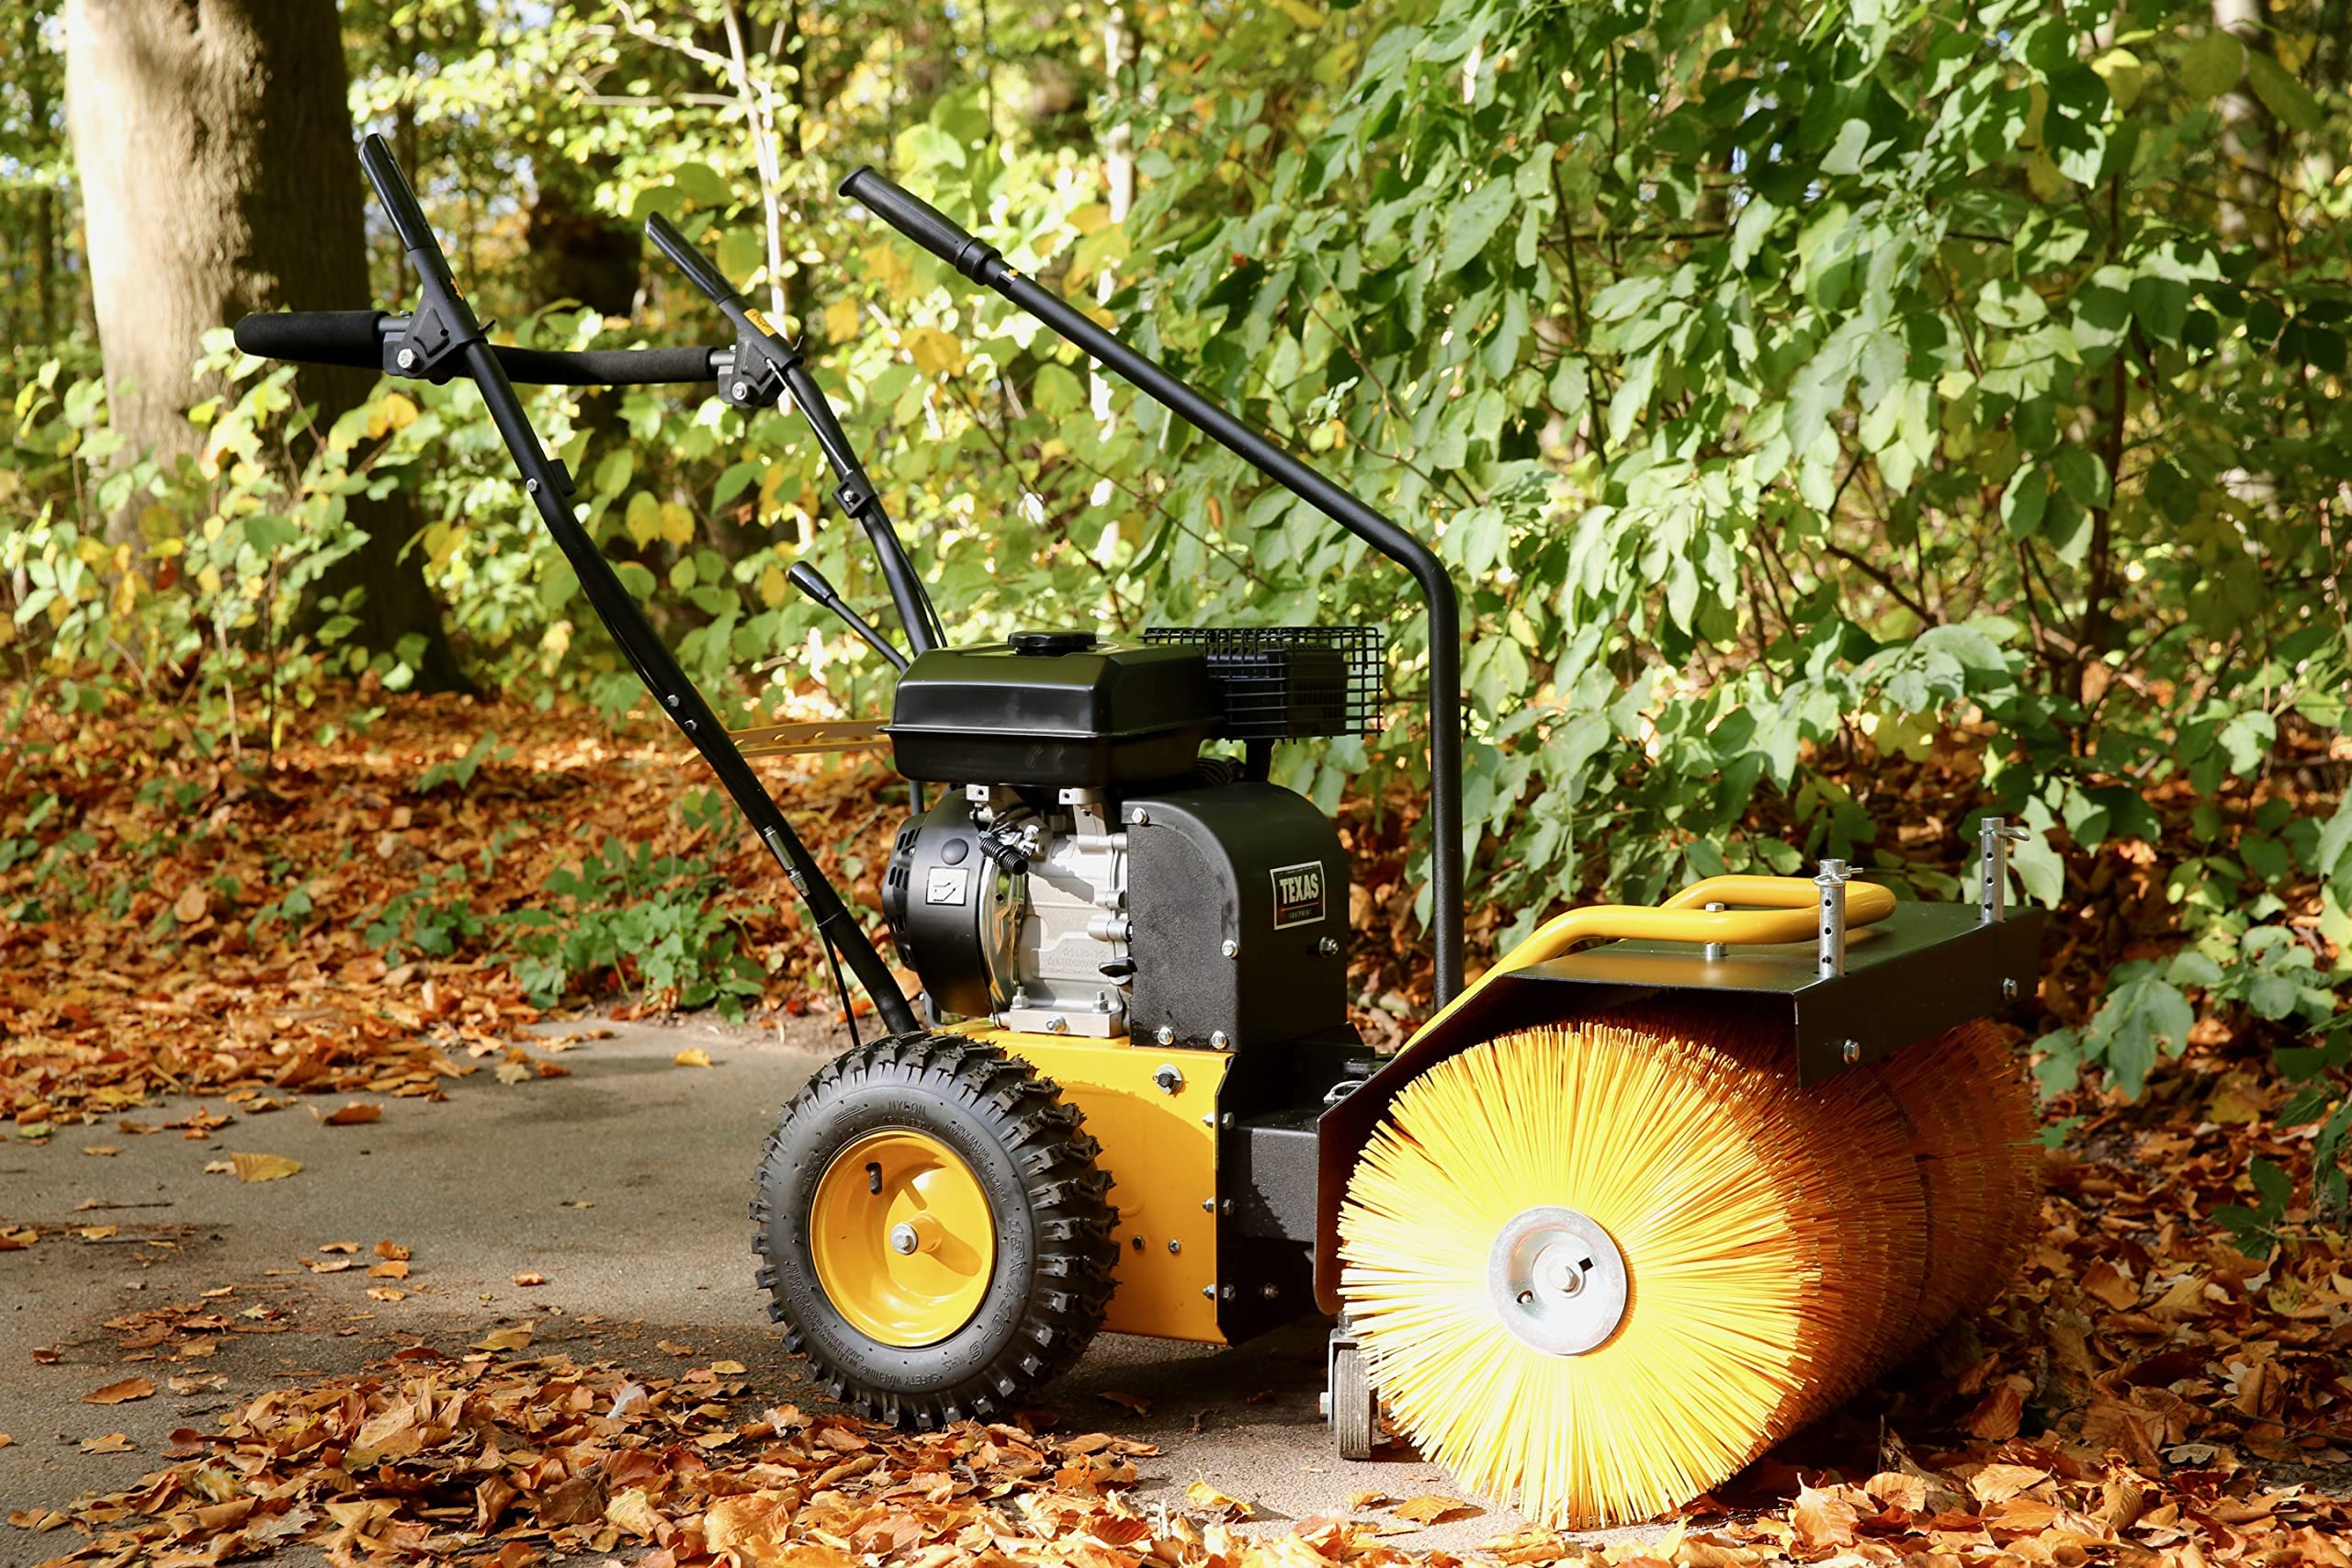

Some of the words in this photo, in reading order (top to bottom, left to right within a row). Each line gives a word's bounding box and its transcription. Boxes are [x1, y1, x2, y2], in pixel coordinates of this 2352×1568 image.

[1279, 874, 1319, 904] TEXAS
[888, 1100, 926, 1115] NYLON
[904, 1373, 940, 1386] SAFETY
